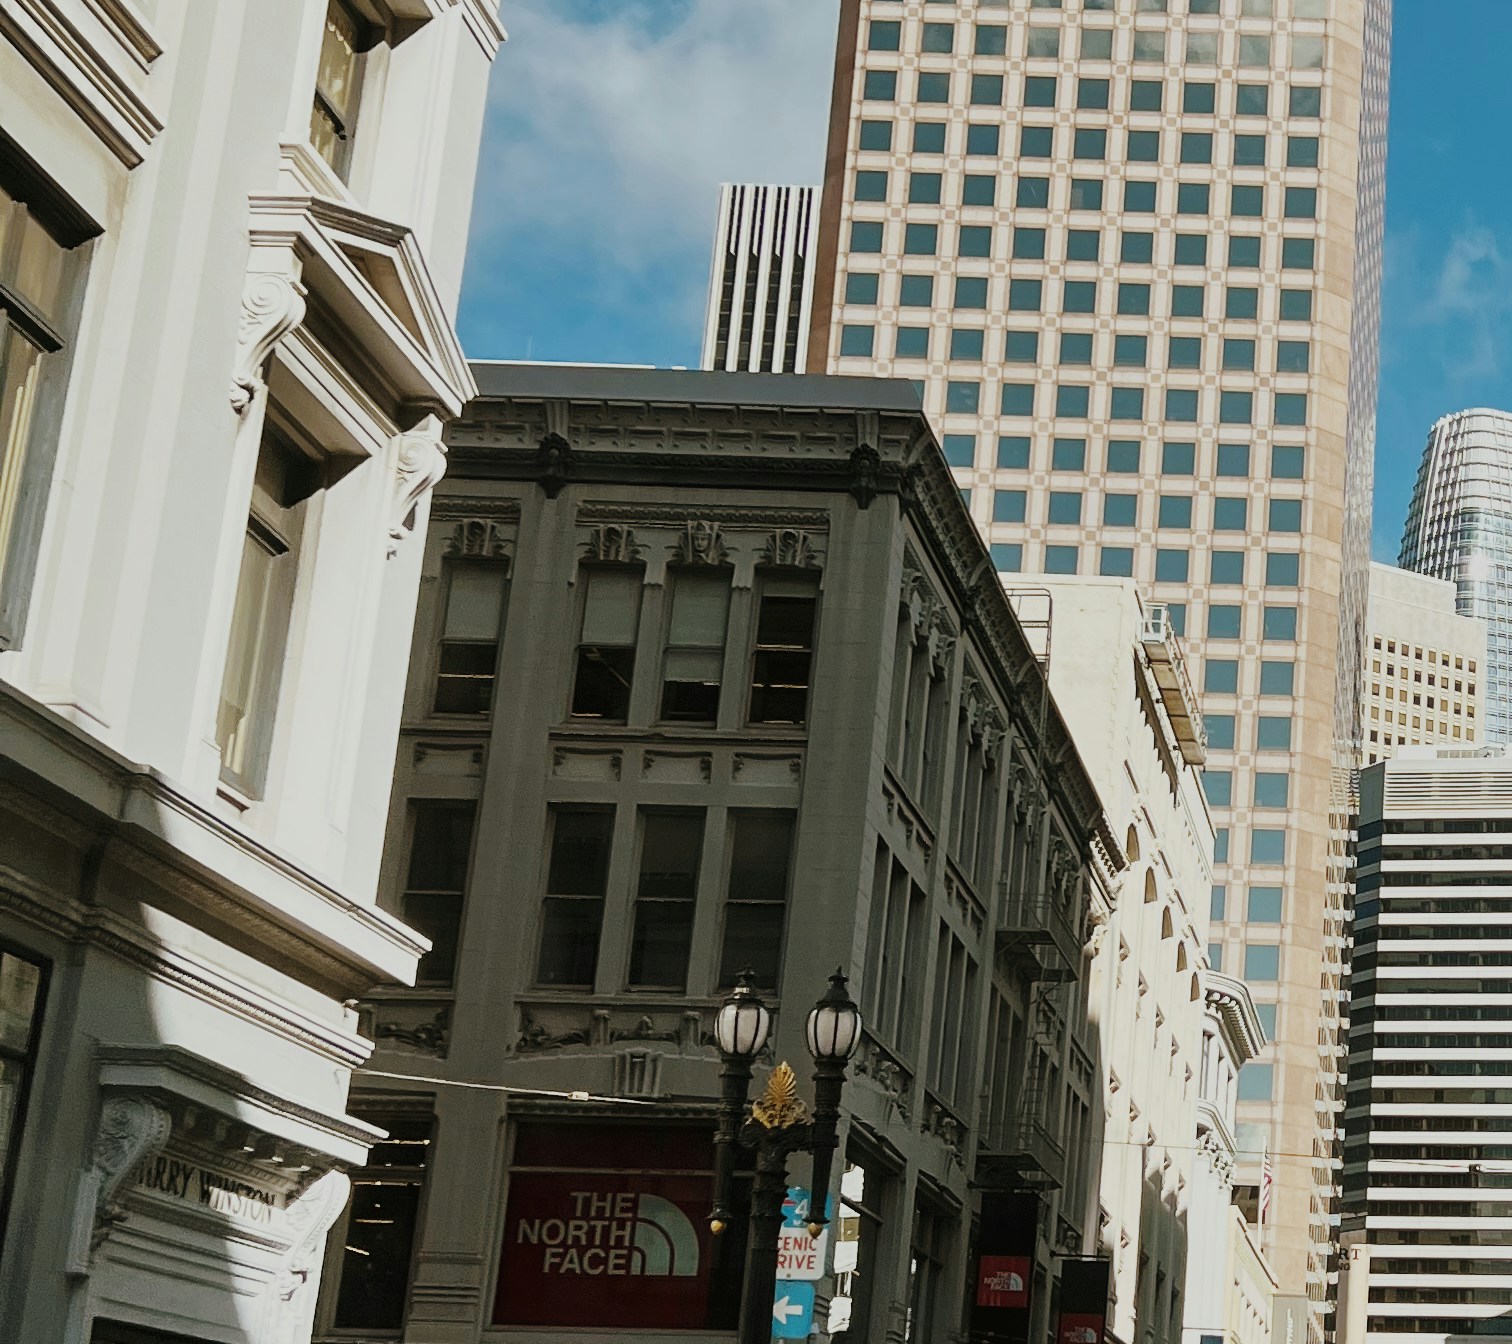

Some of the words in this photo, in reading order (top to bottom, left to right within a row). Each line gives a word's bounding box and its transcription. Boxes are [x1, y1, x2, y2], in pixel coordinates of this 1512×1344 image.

[570, 1191, 635, 1218] THE
[517, 1218, 633, 1246] NORTH
[542, 1247, 628, 1275] FACE
[777, 1254, 817, 1270] RIVE
